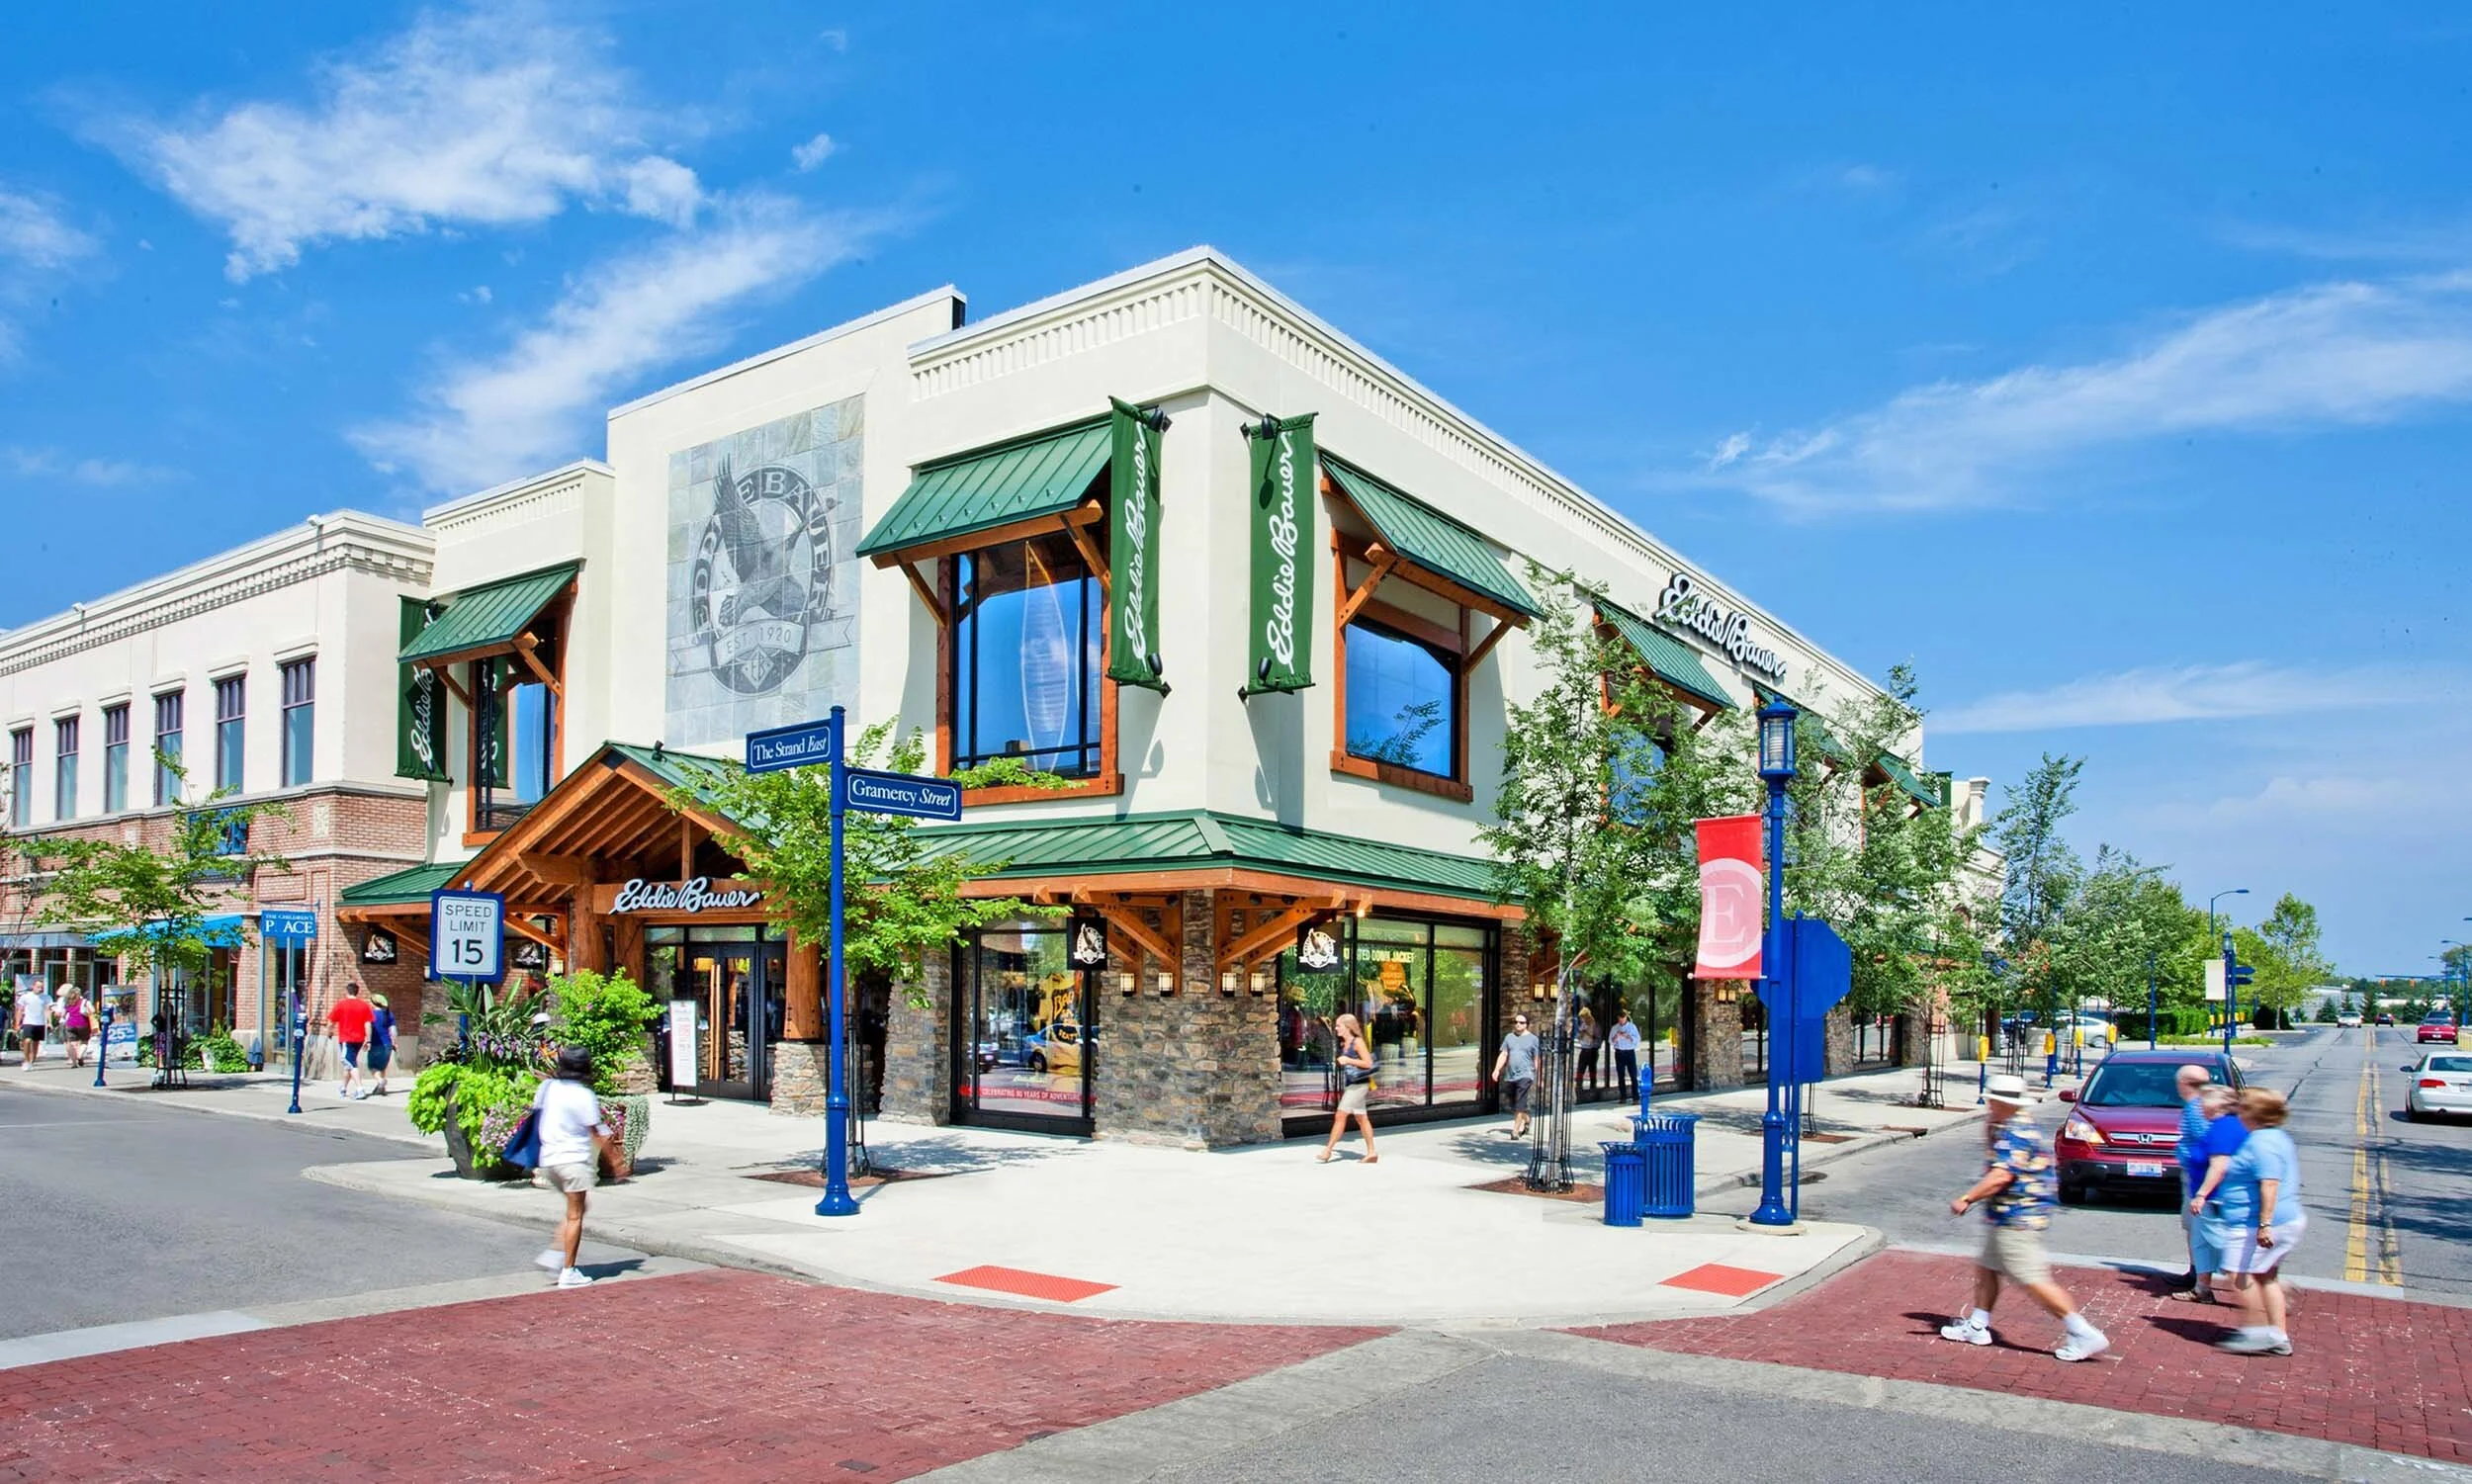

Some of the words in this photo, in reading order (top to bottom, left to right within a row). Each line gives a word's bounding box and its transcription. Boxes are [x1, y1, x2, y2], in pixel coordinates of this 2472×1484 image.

[1124, 421, 1147, 554] Bauer
[1269, 431, 1298, 562] Bauer
[1124, 554, 1148, 672] Eddie
[1267, 560, 1294, 674] Eddie
[1655, 572, 1724, 645] Eddie
[1724, 612, 1787, 677] Bauer
[759, 626, 792, 645] 1920
[753, 744, 774, 761] The
[775, 738, 805, 757] Strand
[807, 735, 827, 752] East
[852, 778, 917, 806] Gramercy
[920, 788, 951, 807] Street
[445, 905, 492, 918] SPEED
[609, 878, 681, 916] Eddie
[676, 876, 759, 914] Bauer
[265, 919, 313, 934] PACE
[450, 919, 486, 932] LIMIT
[1703, 883, 1746, 944] E
[451, 939, 484, 966] 15
